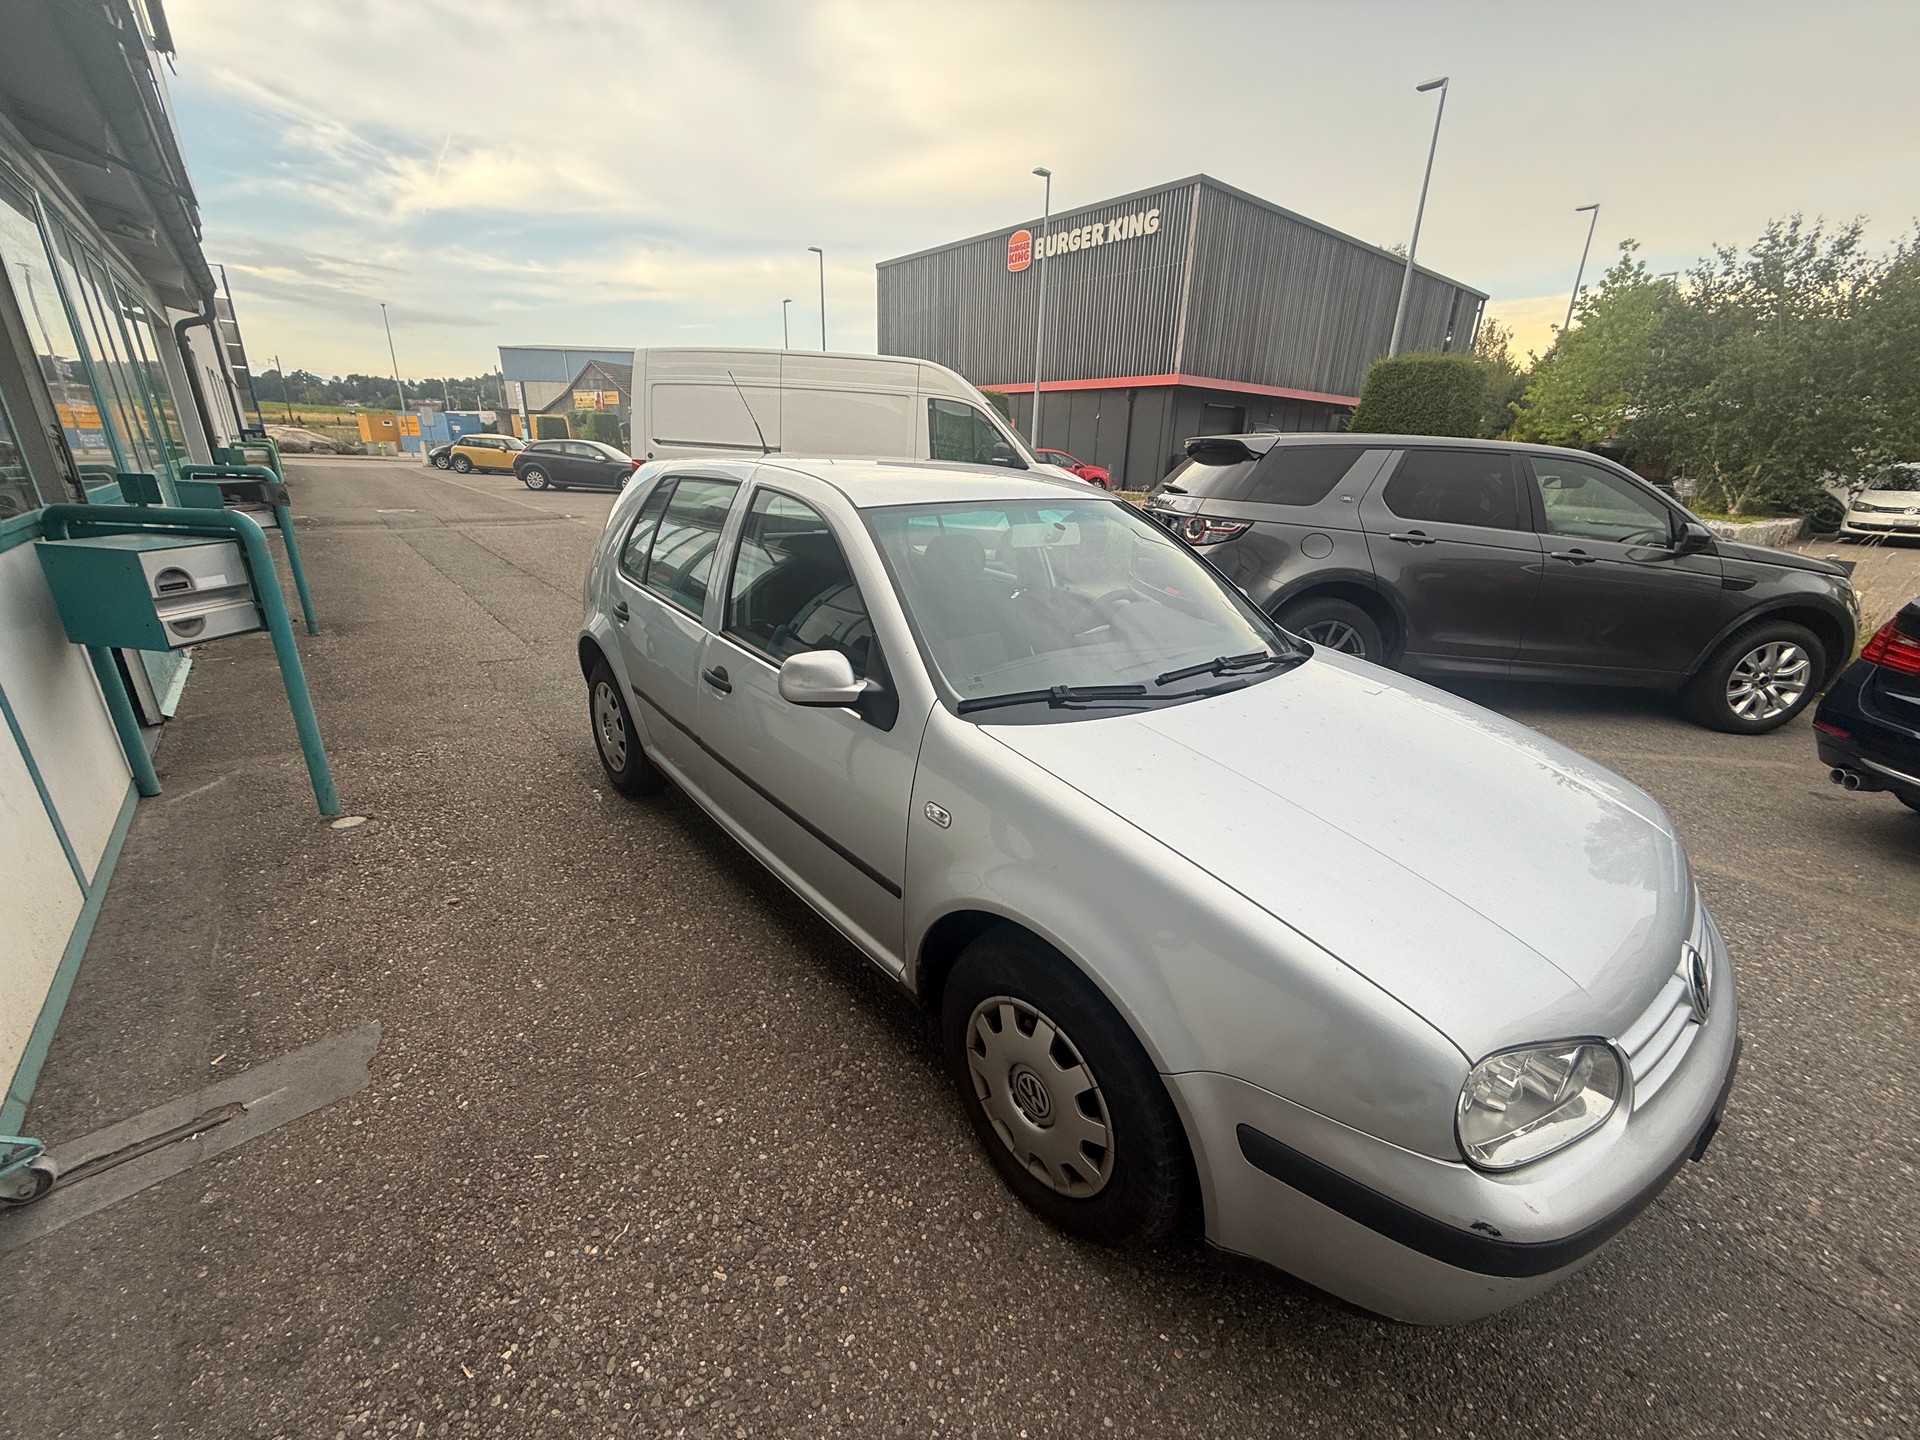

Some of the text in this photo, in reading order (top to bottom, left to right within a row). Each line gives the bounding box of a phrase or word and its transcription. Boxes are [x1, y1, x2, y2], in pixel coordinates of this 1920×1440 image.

[1034, 209, 1160, 260] BURGER KING
[1009, 242, 1030, 253] BURGER
[1009, 250, 1030, 264] KING
